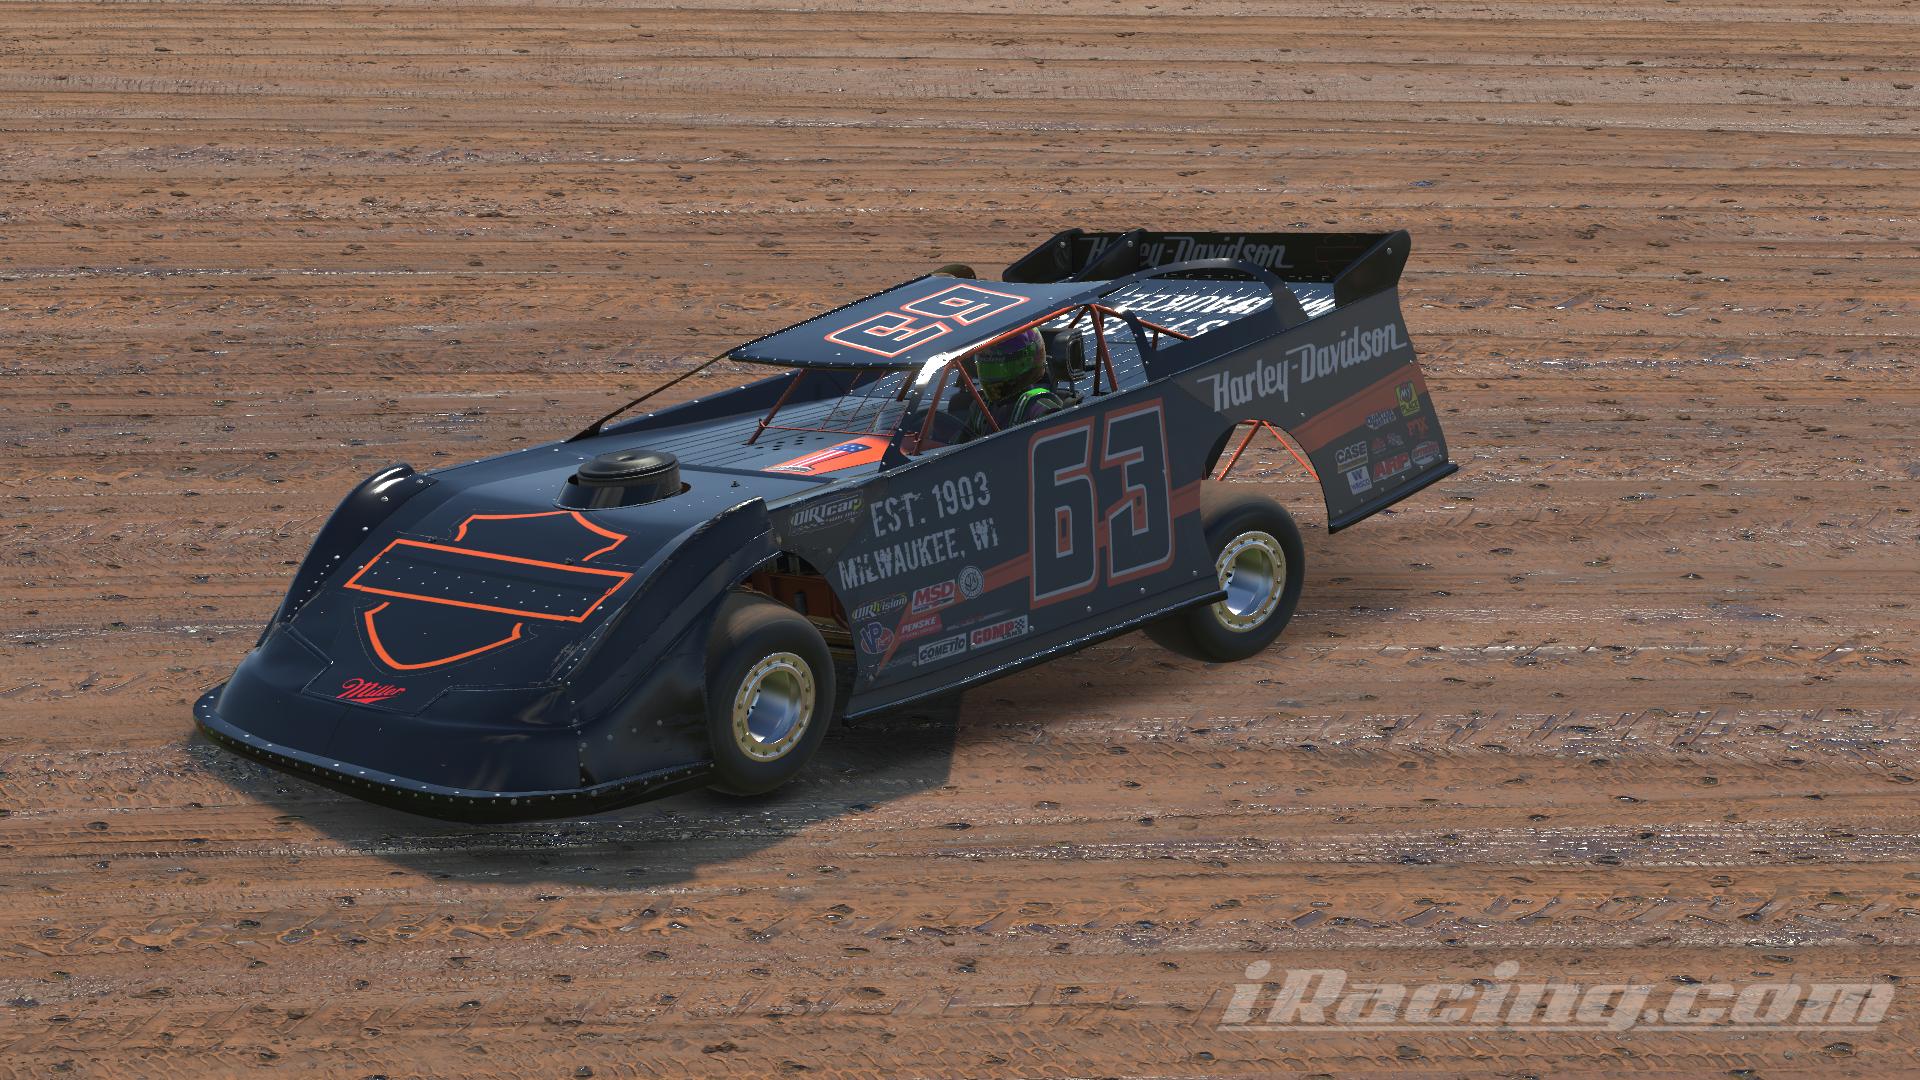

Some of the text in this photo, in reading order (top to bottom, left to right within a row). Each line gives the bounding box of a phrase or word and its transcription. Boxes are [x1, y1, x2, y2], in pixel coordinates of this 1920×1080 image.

[1080, 236, 1294, 268] Hey-Davidson
[1197, 323, 1407, 412] Harley-Davidson
[1336, 441, 1368, 462] CASE
[870, 472, 991, 537] EST. 1903
[1028, 397, 1175, 609] 63
[838, 528, 966, 591] MILWAUKEE,
[914, 580, 956, 605] MSD
[902, 616, 937, 634] PENSKE
[972, 620, 1015, 645] COMP
[336, 678, 406, 702] Miller
